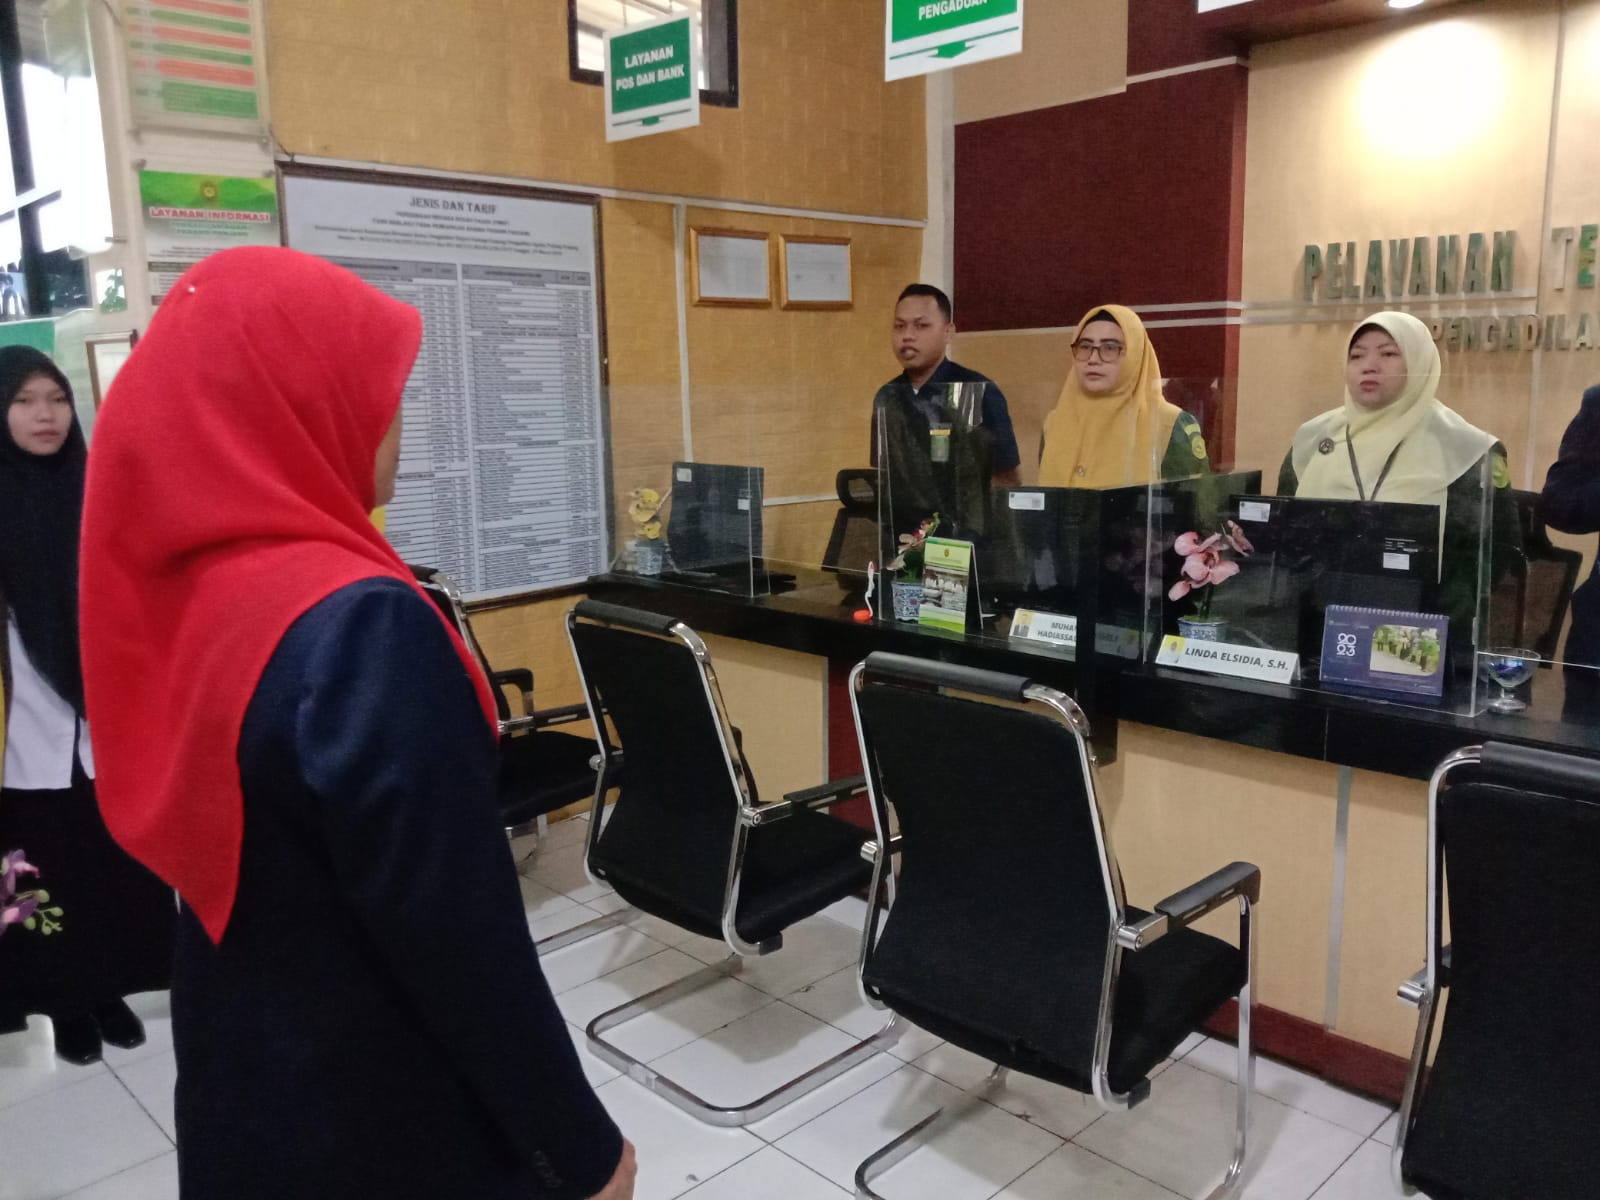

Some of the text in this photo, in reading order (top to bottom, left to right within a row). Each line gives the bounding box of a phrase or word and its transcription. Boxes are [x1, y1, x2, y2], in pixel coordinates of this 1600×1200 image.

[918, 0, 988, 21] PENGADU
[624, 44, 674, 69] LAYANAN
[616, 64, 685, 91] POS DAN BANK
[150, 207, 269, 222] LAYANAN INFORMASI
[409, 197, 497, 214] JENIS DAN TARIF
[1426, 315, 1600, 351] PENGADILA
[1051, 622, 1076, 631] MUHA
[1184, 647, 1289, 671] LINDA ELSIDIA, S.H.
